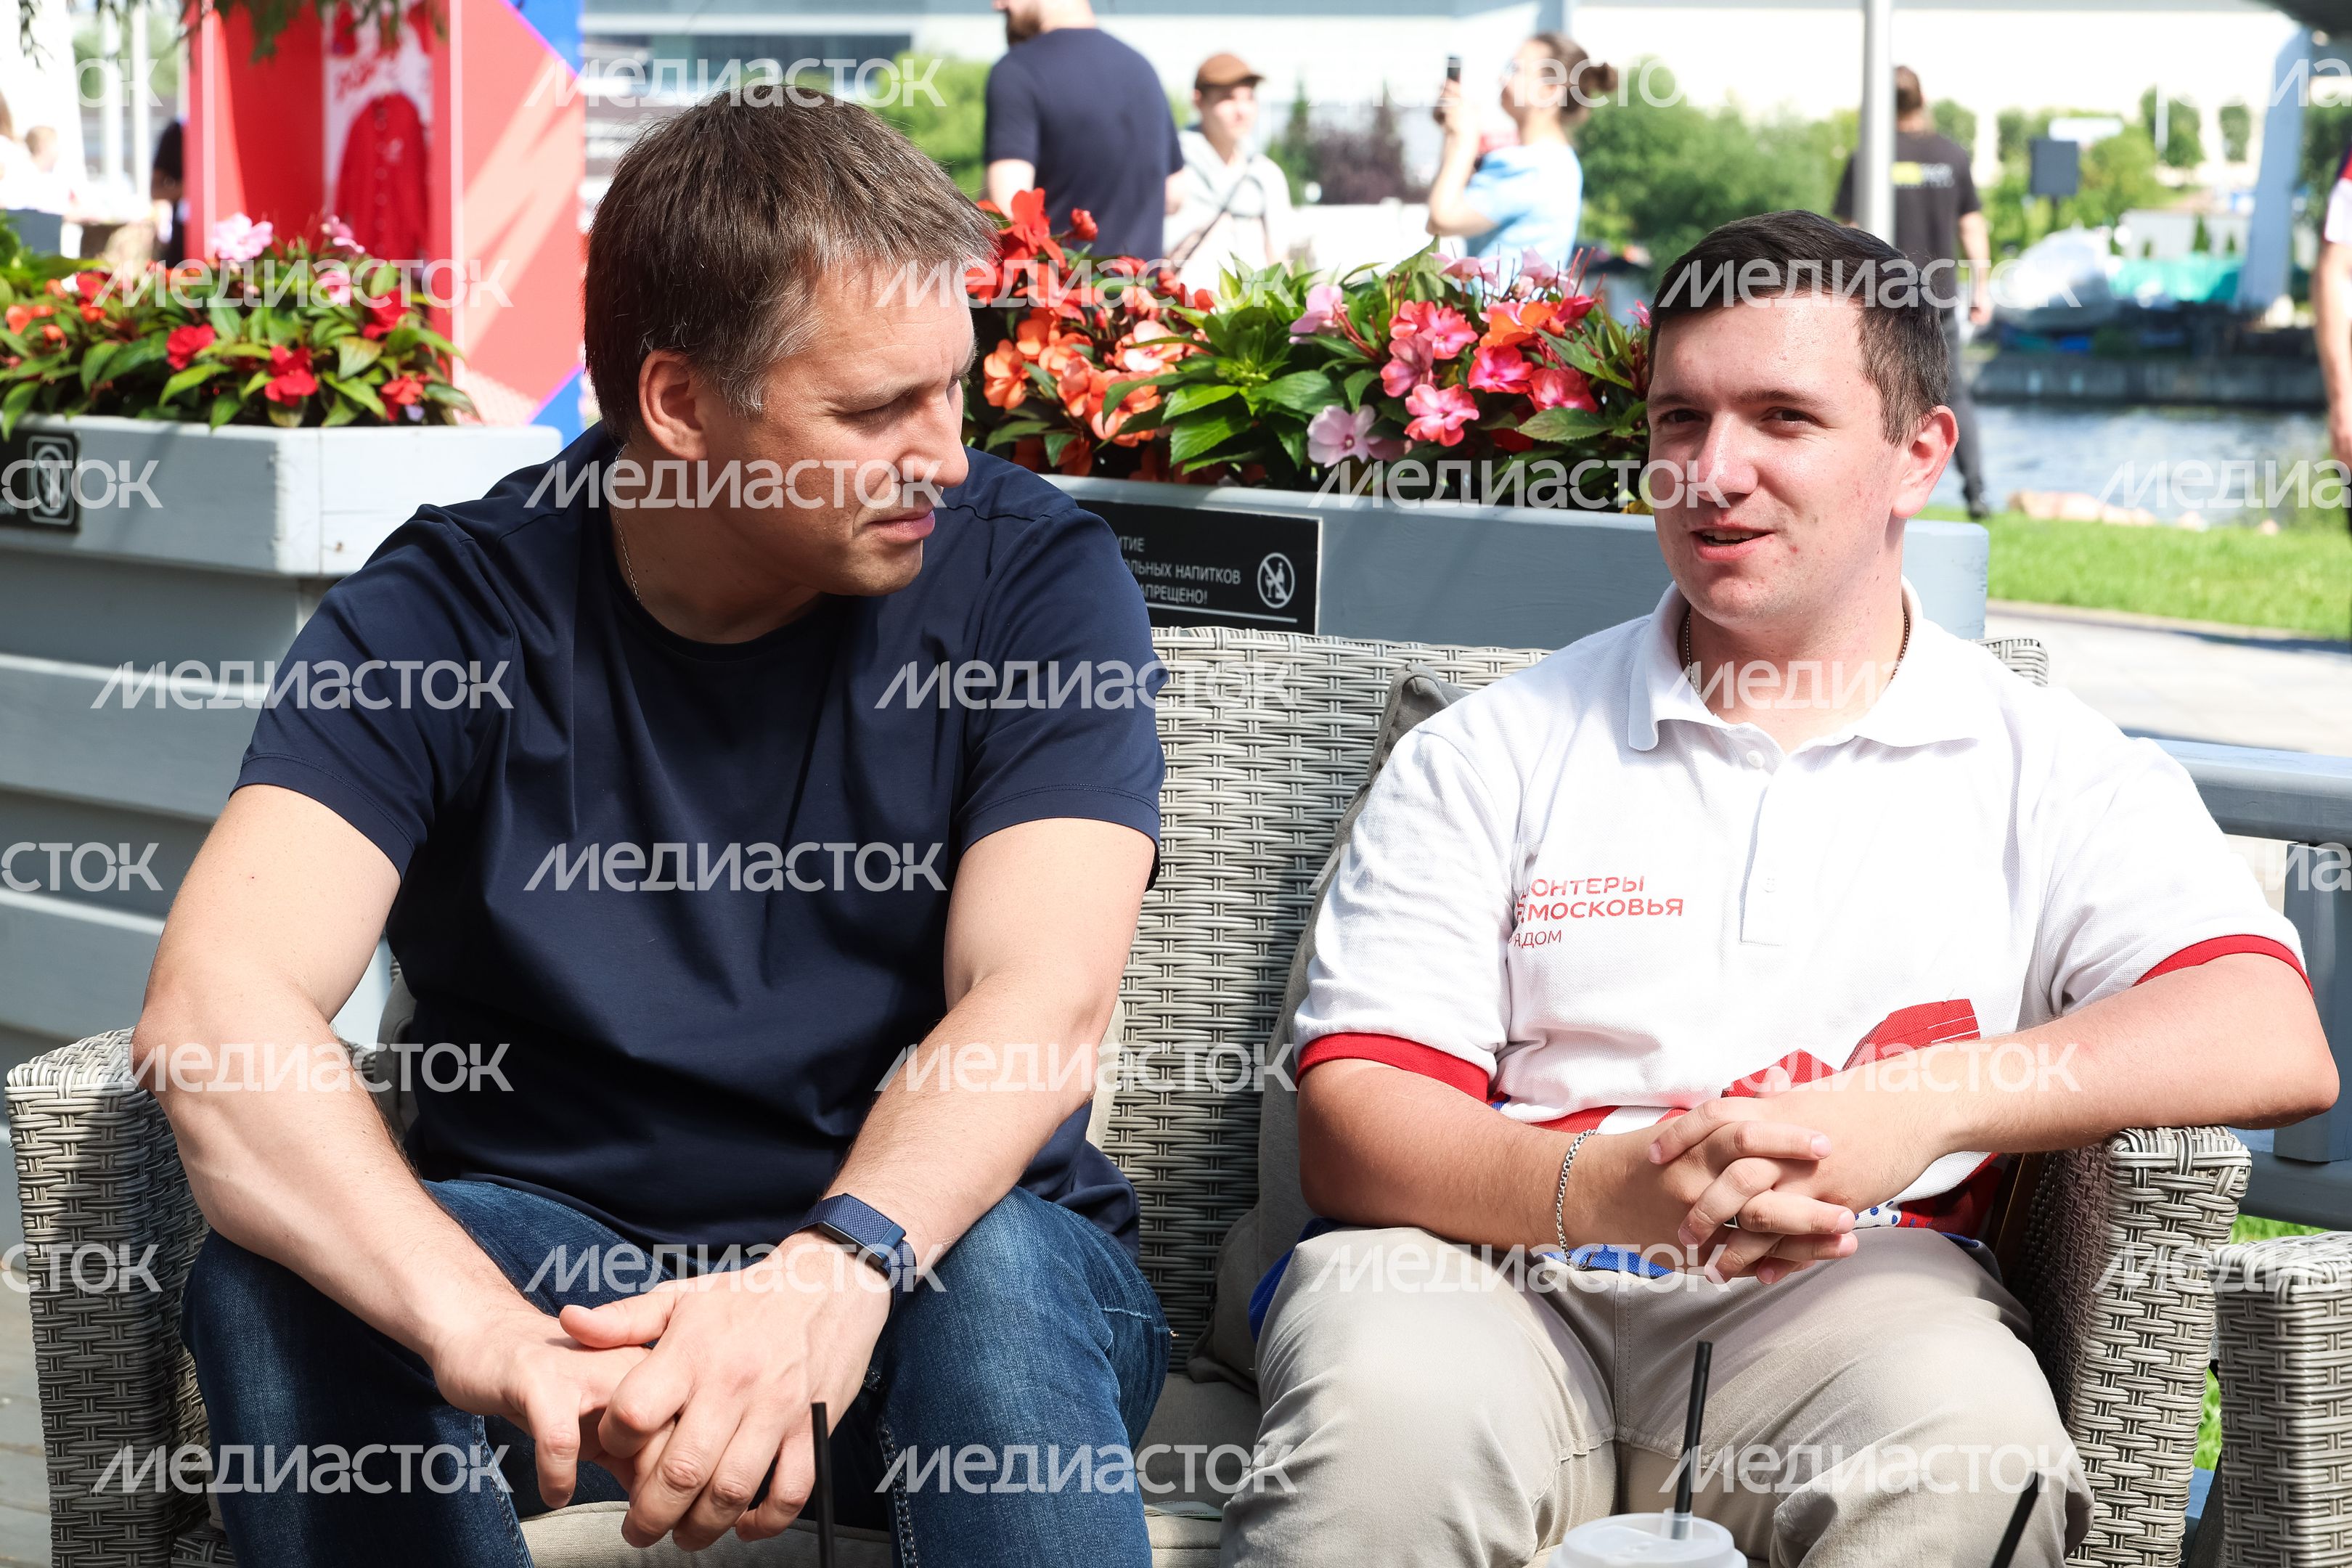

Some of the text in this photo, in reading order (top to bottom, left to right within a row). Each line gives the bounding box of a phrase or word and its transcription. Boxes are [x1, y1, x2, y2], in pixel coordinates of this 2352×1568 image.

[1175, 565, 1241, 585] НАПИТКОВ
[1530, 875, 1644, 897] ОНТЕРЫ
[1509, 929, 1562, 948] ЯДОМ
